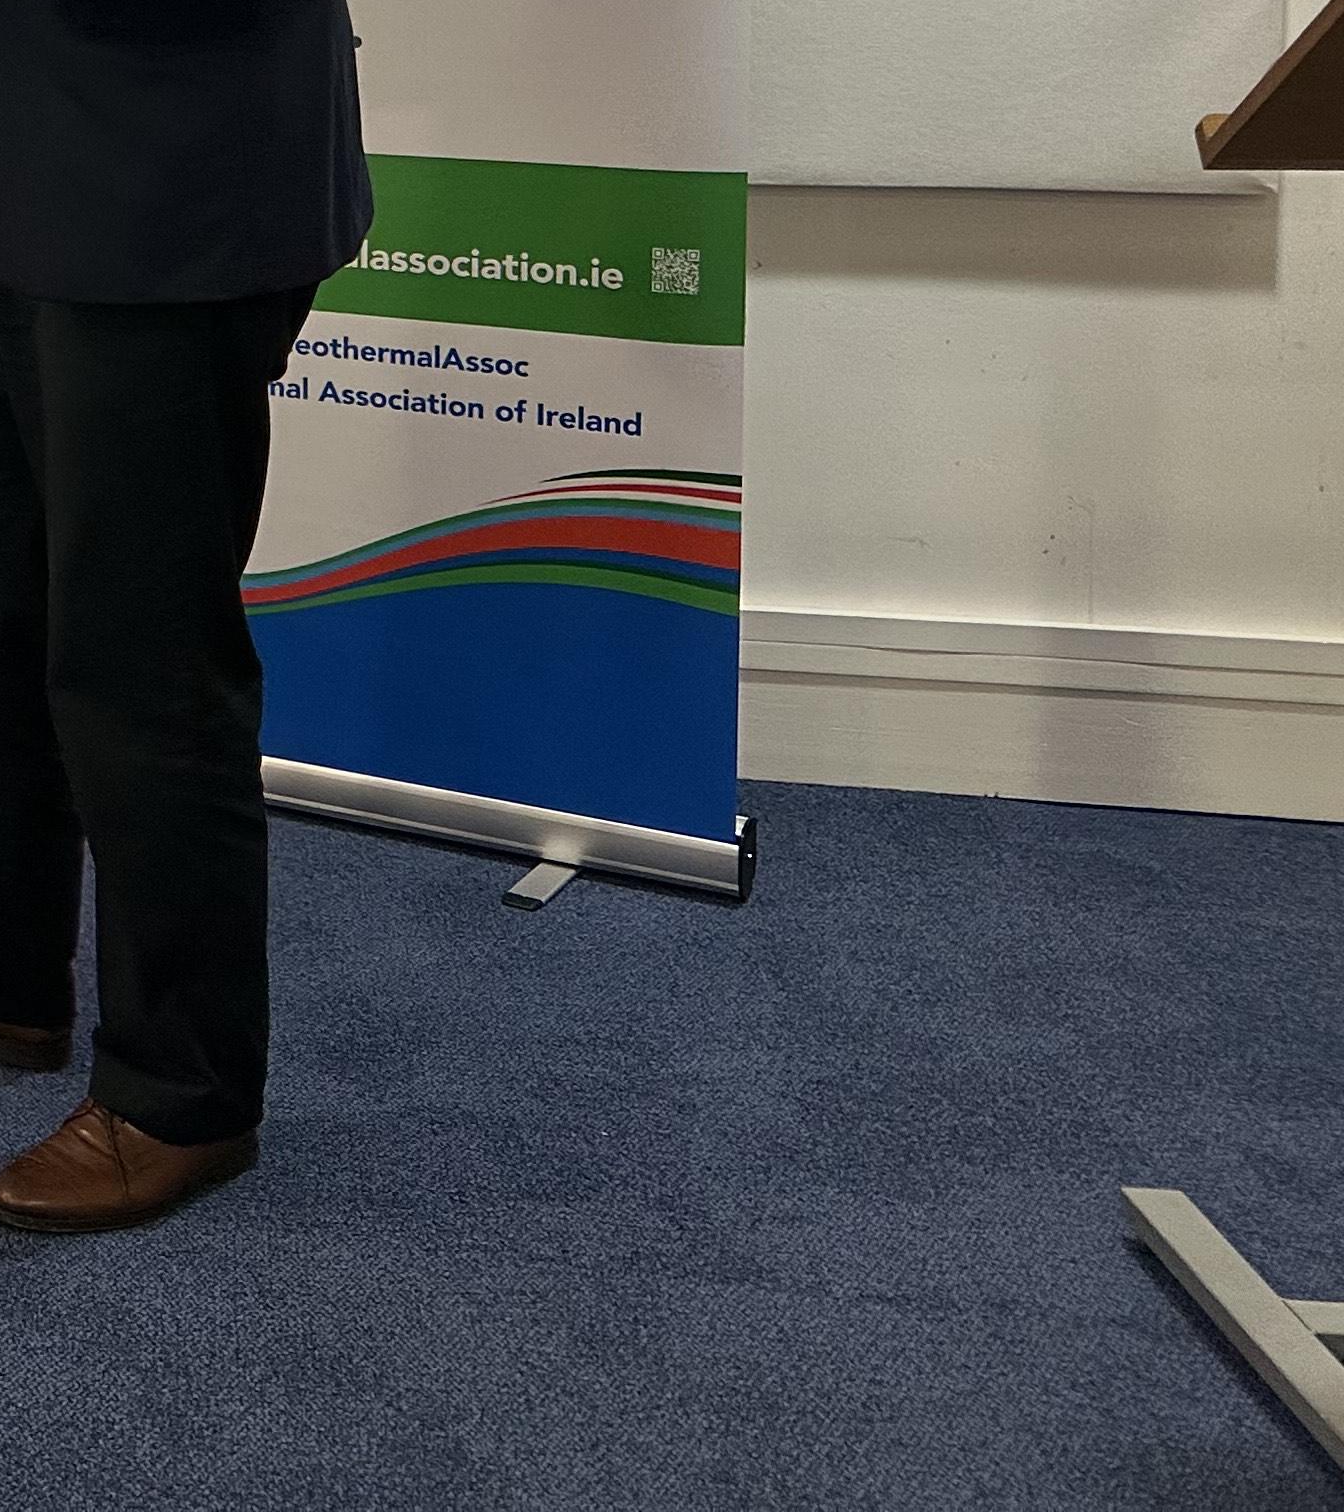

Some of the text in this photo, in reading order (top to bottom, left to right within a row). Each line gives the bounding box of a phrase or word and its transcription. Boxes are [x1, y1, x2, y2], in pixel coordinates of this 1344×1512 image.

[344, 239, 623, 290] lassociation.ie
[295, 336, 529, 378] eothermalAssoc
[318, 381, 484, 419] Association
[495, 399, 527, 424] of
[537, 402, 643, 437] Ireland
